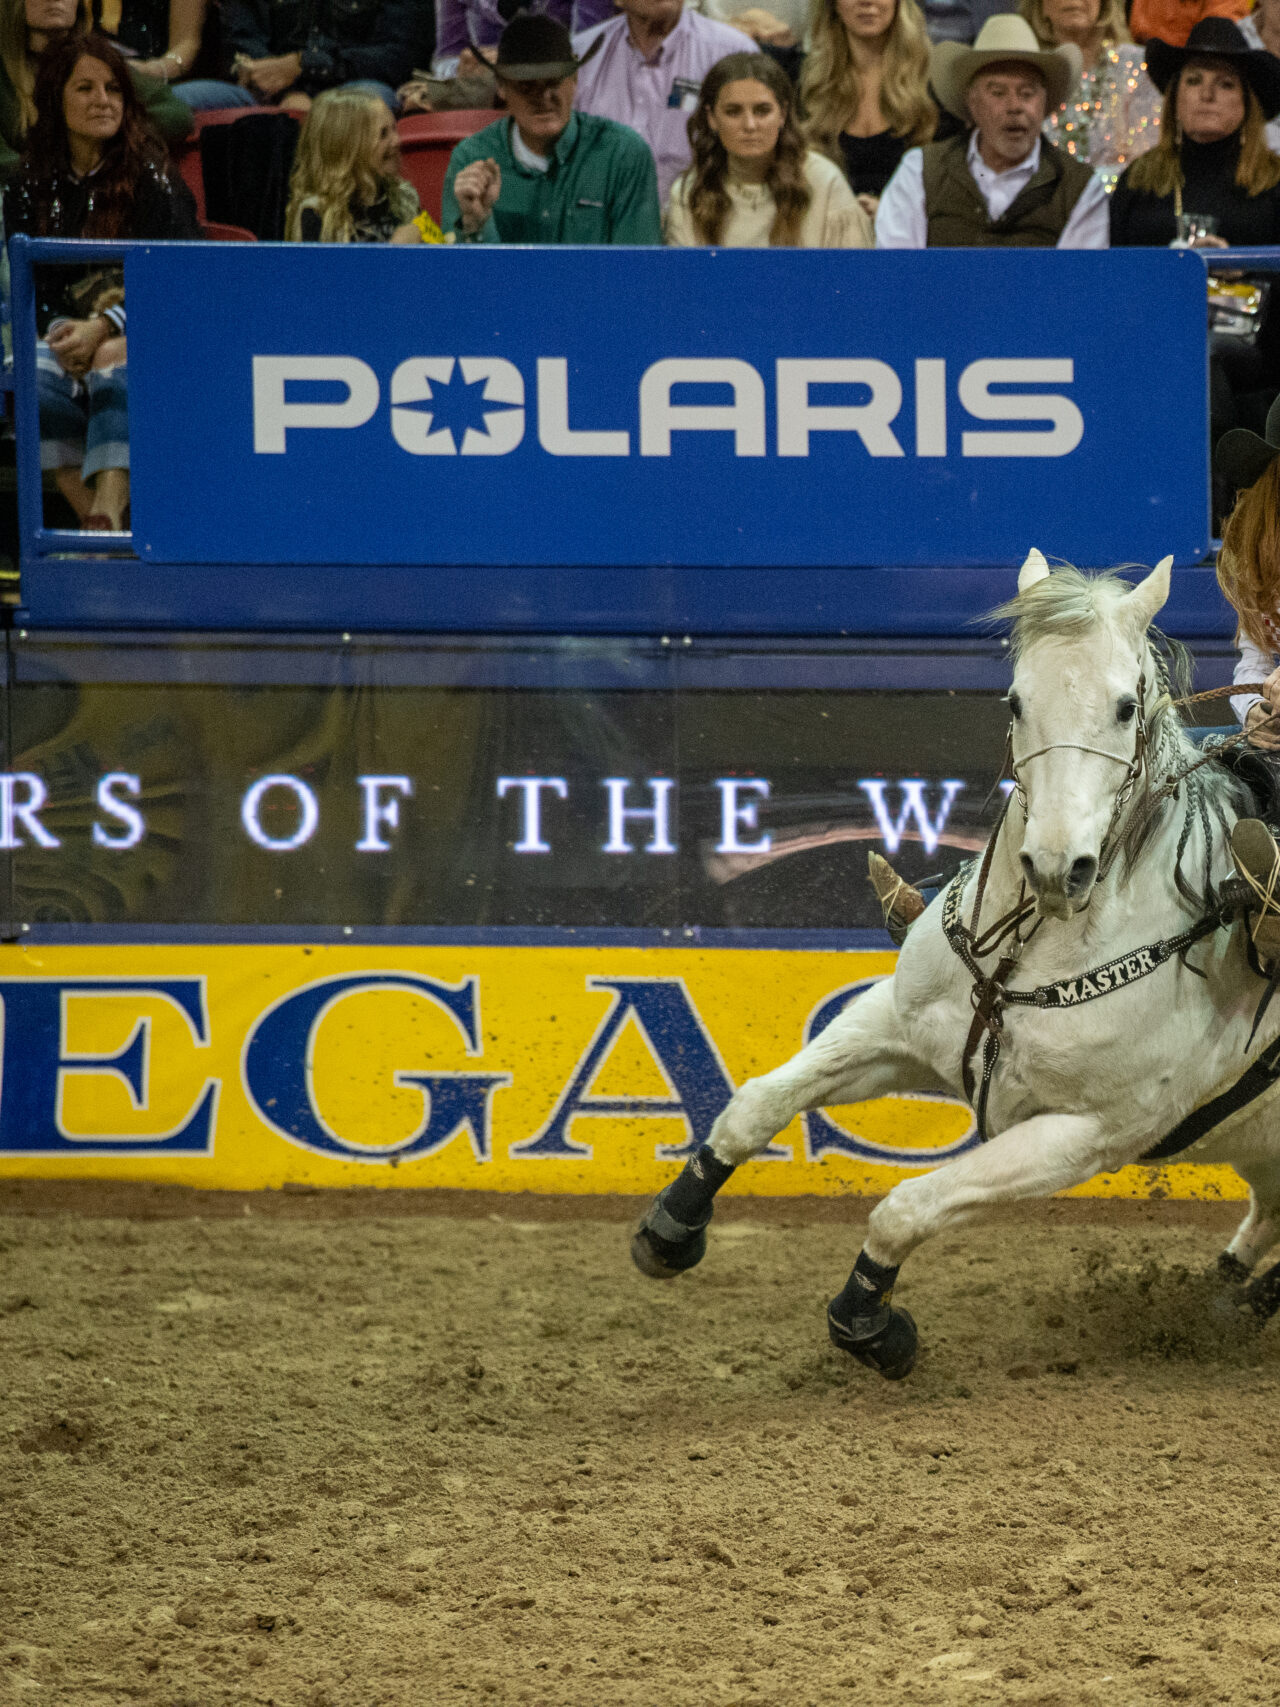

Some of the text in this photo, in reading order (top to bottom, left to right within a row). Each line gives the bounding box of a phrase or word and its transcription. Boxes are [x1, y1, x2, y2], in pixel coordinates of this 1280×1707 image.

[251, 355, 1084, 458] POLARIS
[240, 773, 413, 852] OF
[497, 776, 774, 854] THE
[857, 779, 1016, 855] W
[1055, 949, 1156, 1006] MASTER
